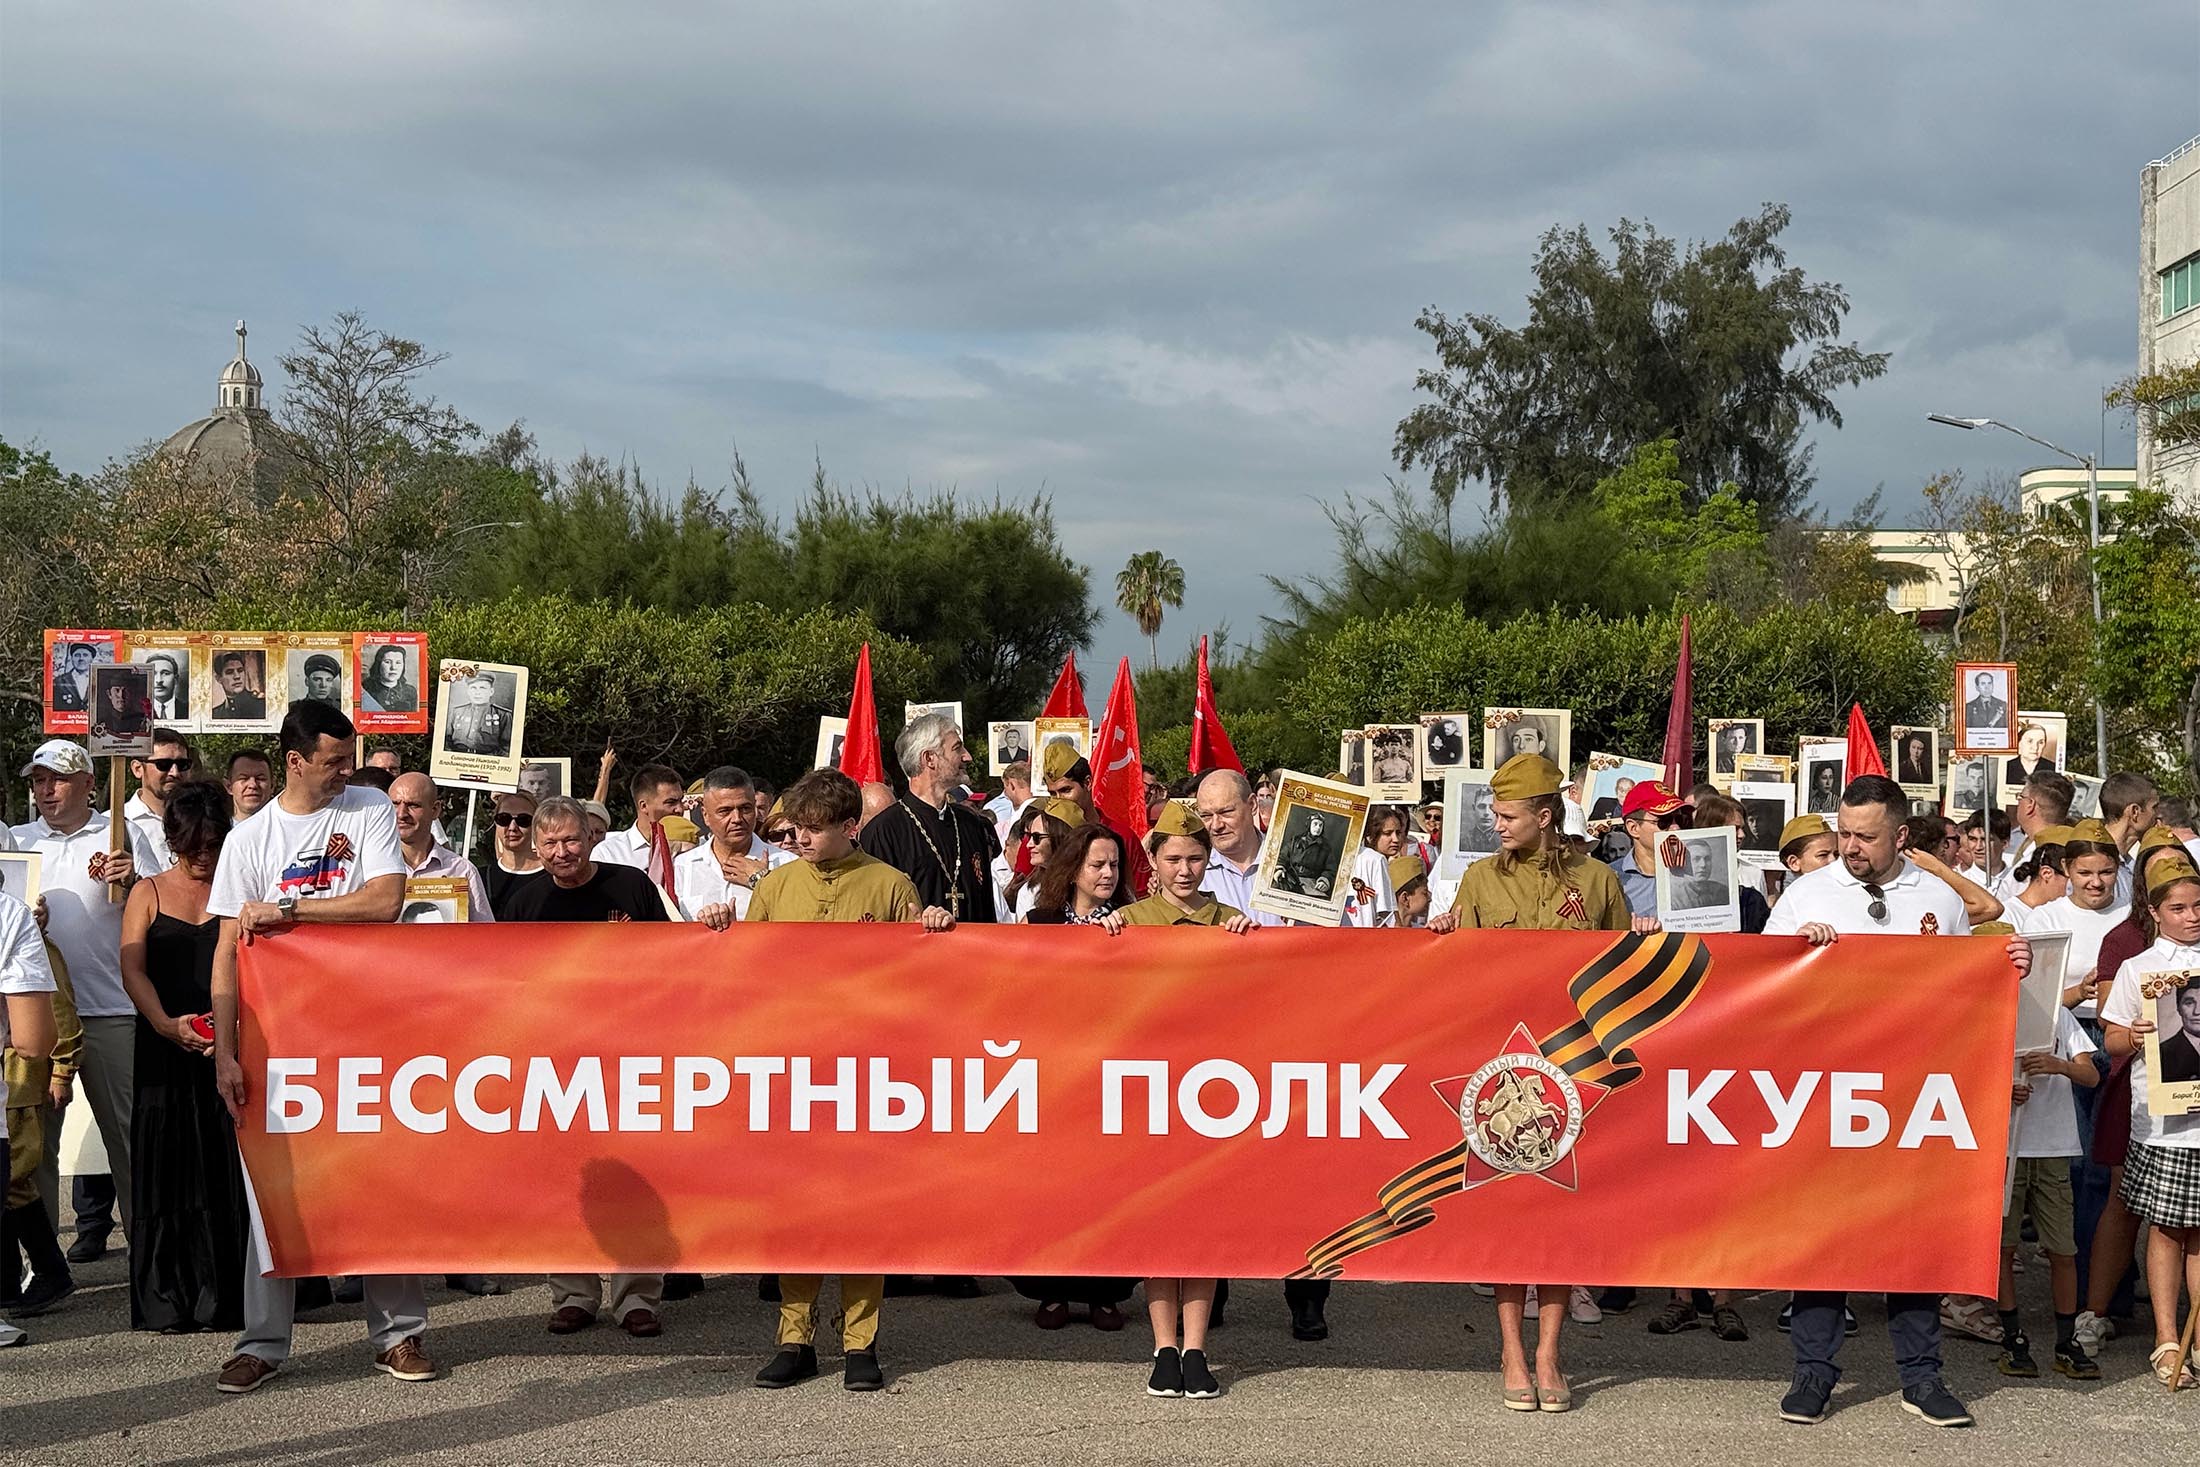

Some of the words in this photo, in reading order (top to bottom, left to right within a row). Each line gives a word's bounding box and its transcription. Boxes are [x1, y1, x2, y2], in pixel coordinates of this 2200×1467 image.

[266, 1039, 1039, 1134] БЕССМЕРТНЫЙ
[1102, 1058, 1410, 1139] ПОЛК
[1667, 1068, 1979, 1150] КУБА
[1462, 1055, 1520, 1136] БЕССМЕРТНЫЙ
[1525, 1056, 1563, 1080] ПОЛК
[1559, 1078, 1582, 1137] РОССИИ
